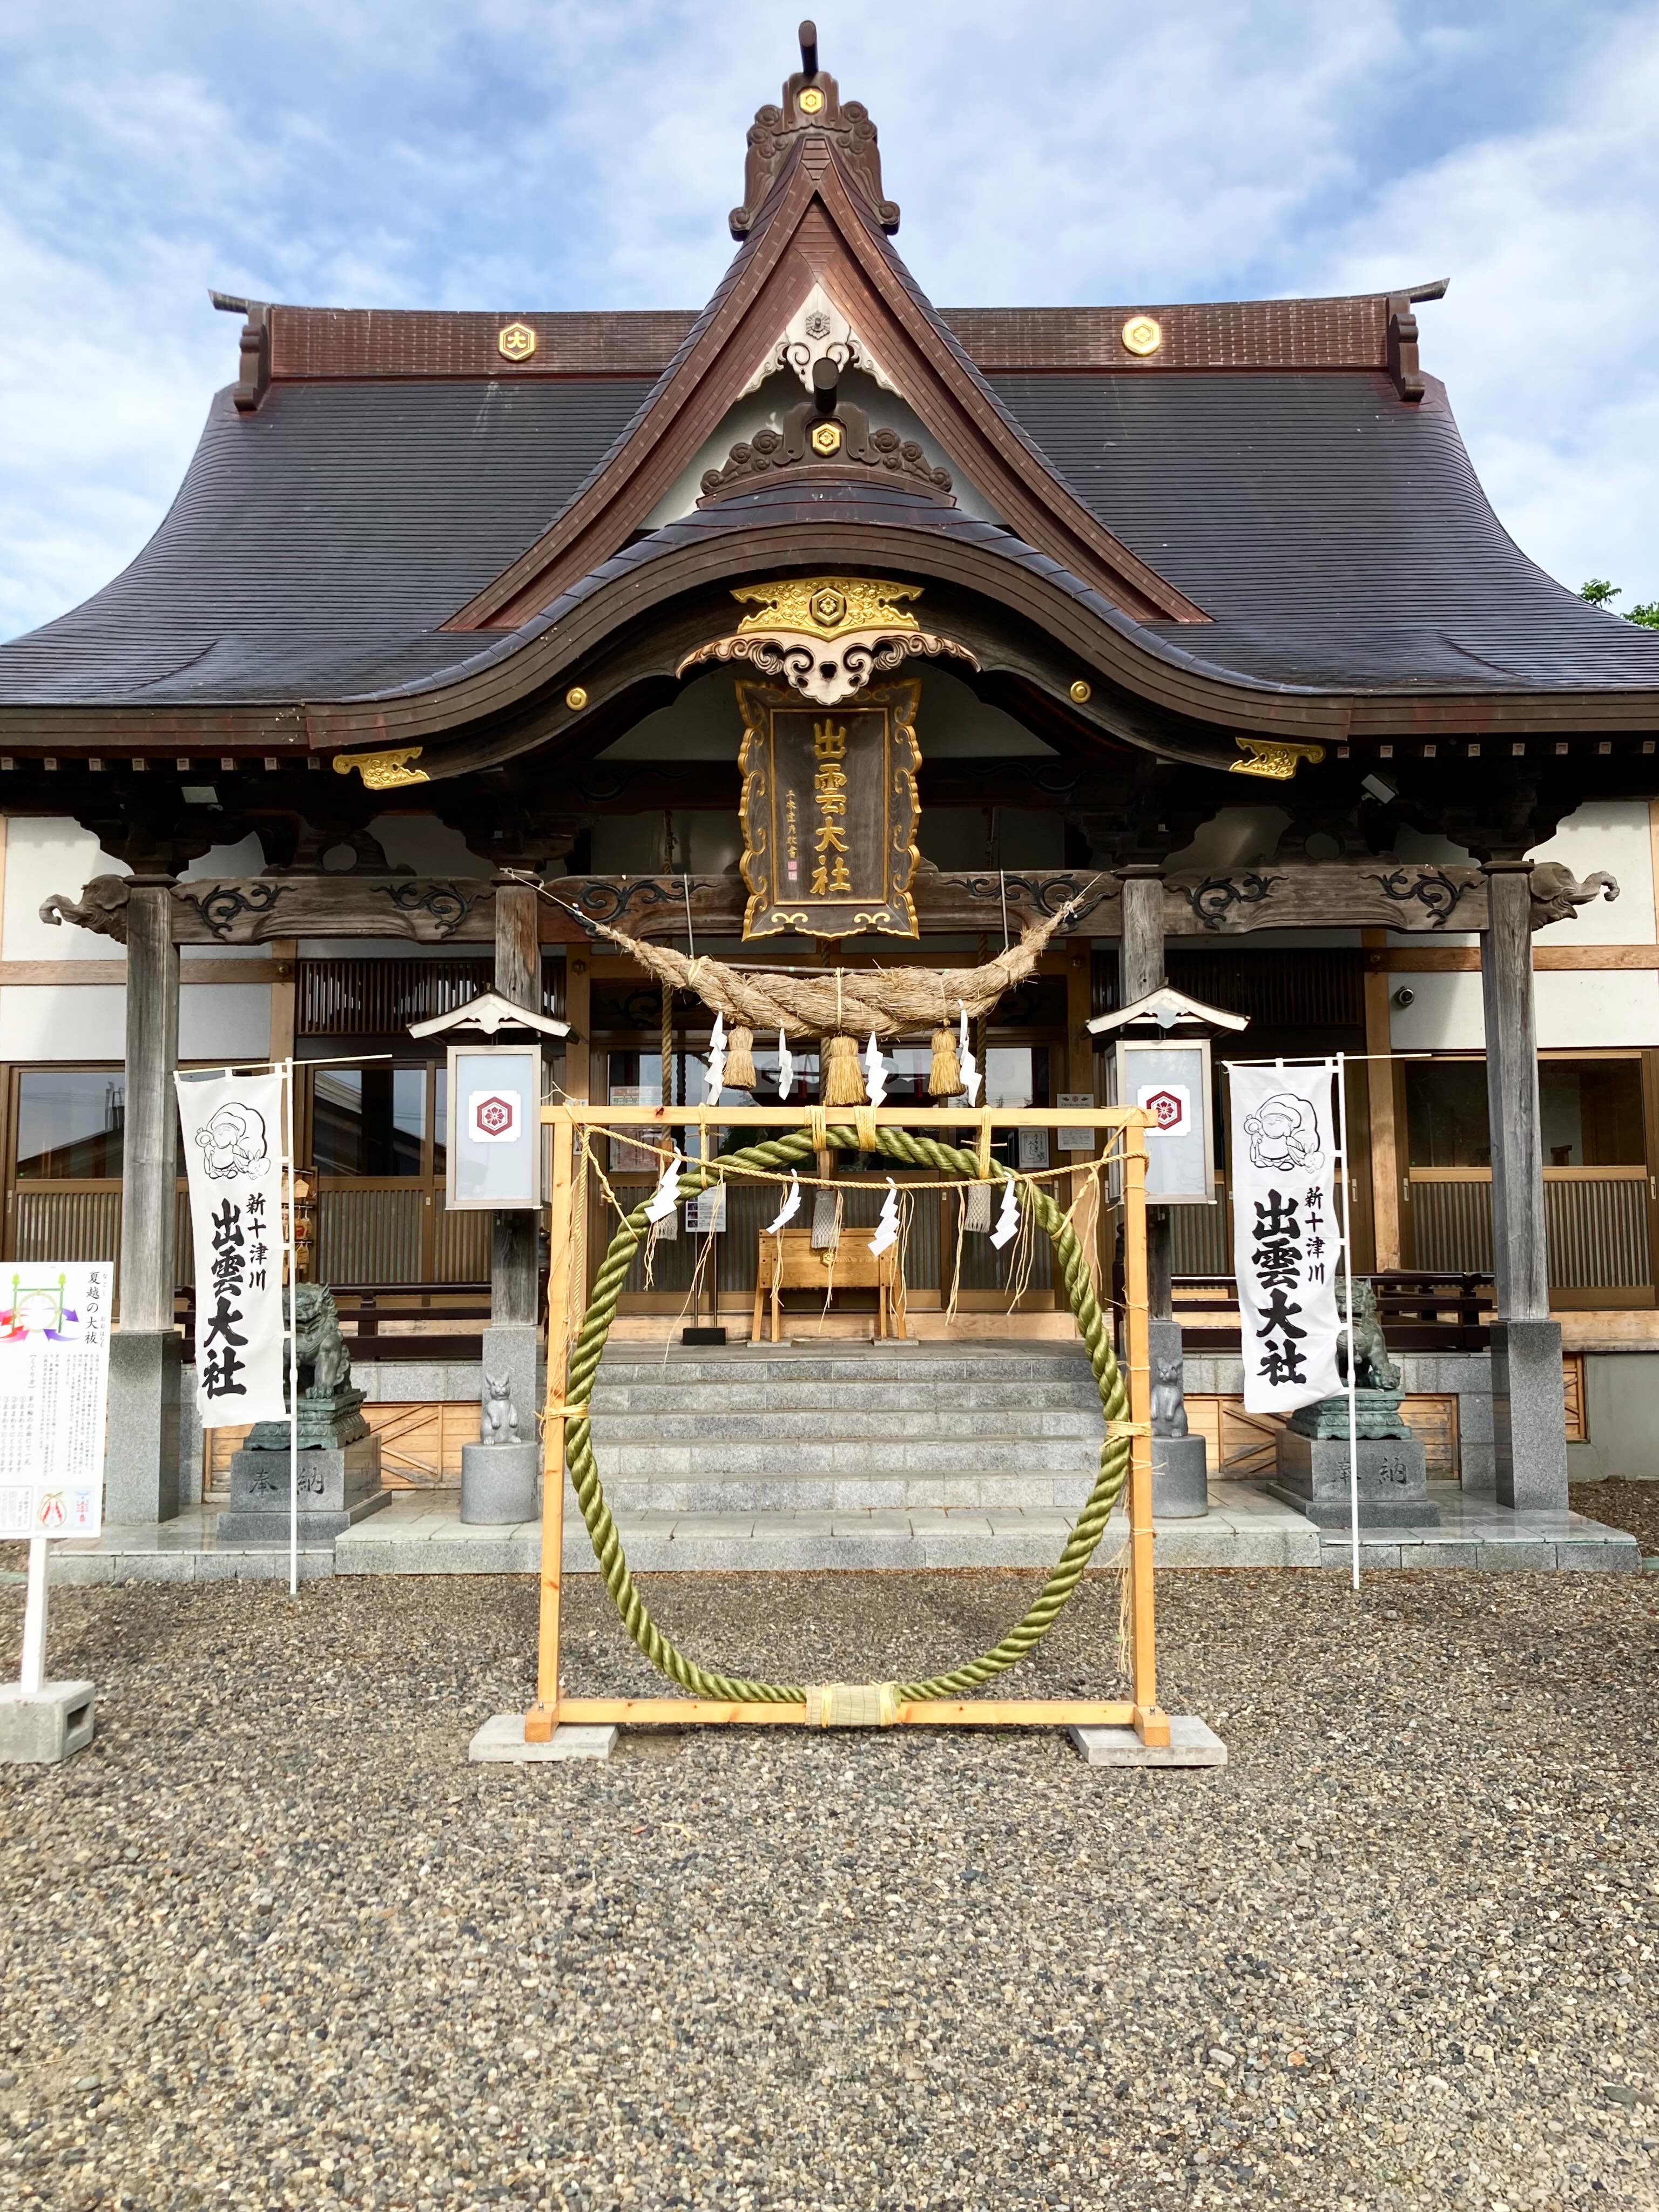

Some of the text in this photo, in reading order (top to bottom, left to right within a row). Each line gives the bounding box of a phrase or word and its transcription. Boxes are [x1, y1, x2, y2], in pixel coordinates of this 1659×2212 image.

[810, 718, 851, 895] 出雲大社
[201, 1197, 249, 1400] 出雲大社
[246, 1192, 269, 1291] 新十津川
[1251, 1189, 1309, 1387] 出雲大社
[1304, 1186, 1325, 1285] 新十津川
[84, 1271, 101, 1345] 夏越の大祓
